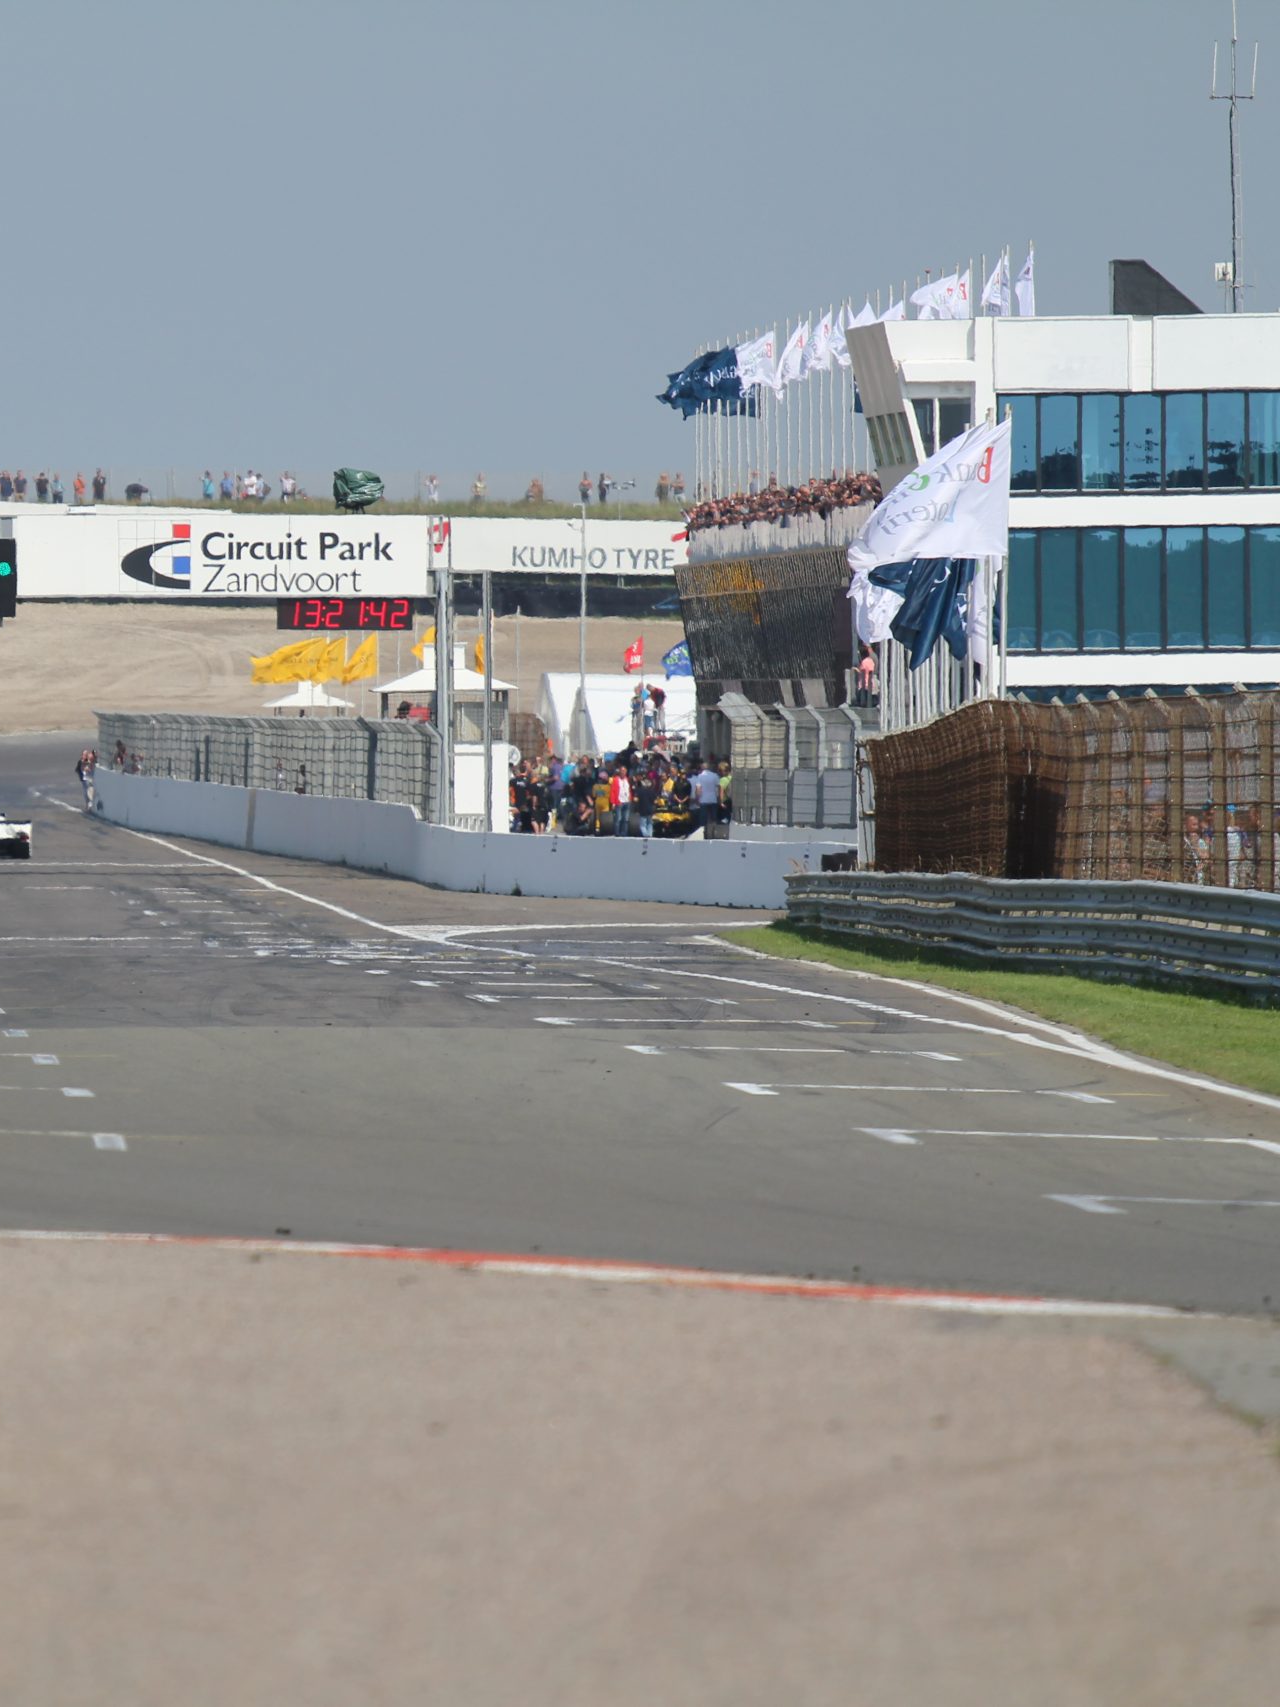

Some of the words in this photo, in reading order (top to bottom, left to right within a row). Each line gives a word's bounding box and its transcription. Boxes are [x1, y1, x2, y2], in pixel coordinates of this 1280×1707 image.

[201, 531, 308, 561] Circuit
[319, 532, 394, 561] Park
[511, 546, 607, 568] KUMHO
[612, 548, 676, 570] TYRE
[202, 564, 363, 593] Zandvoort
